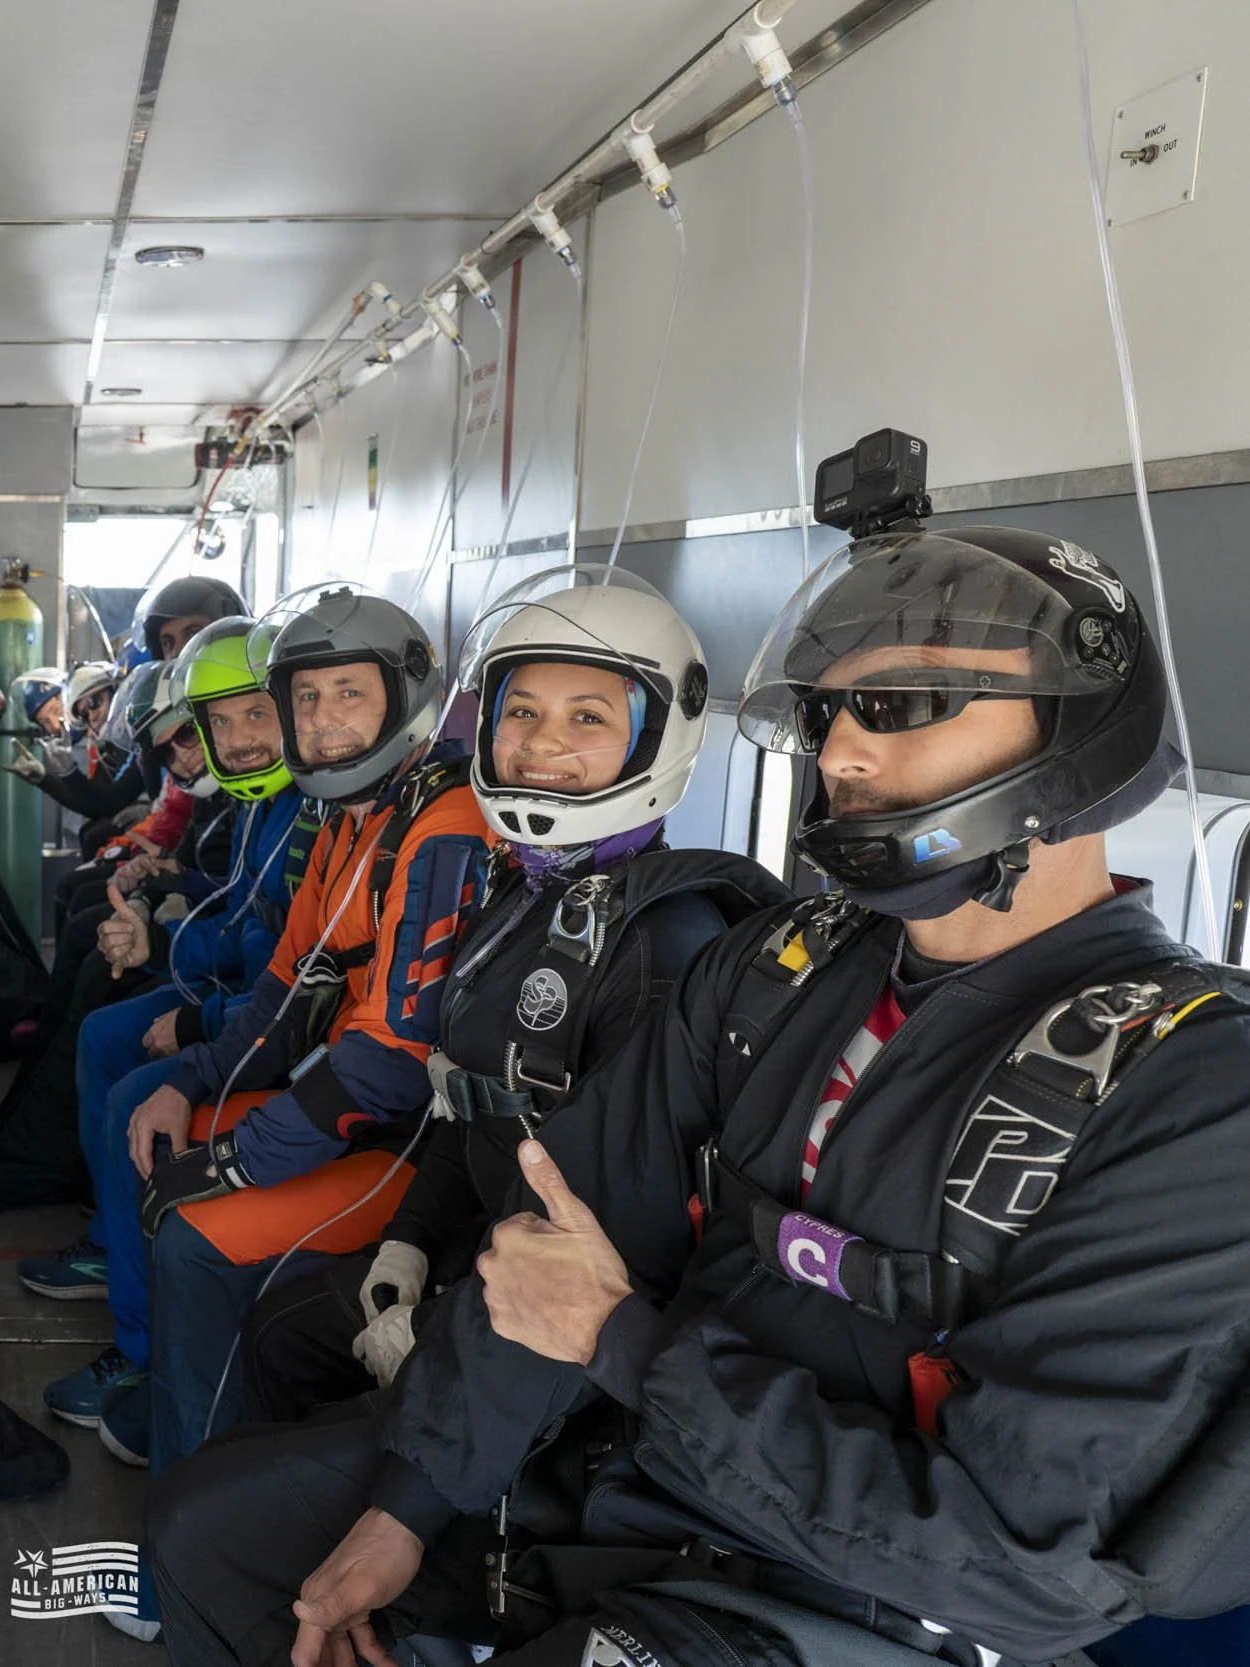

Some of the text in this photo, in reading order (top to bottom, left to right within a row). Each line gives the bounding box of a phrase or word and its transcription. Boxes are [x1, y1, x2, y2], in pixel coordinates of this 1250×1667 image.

[1144, 123, 1166, 139] WINCH
[1163, 139, 1178, 153] OUT
[794, 1214, 847, 1239] CYPRES
